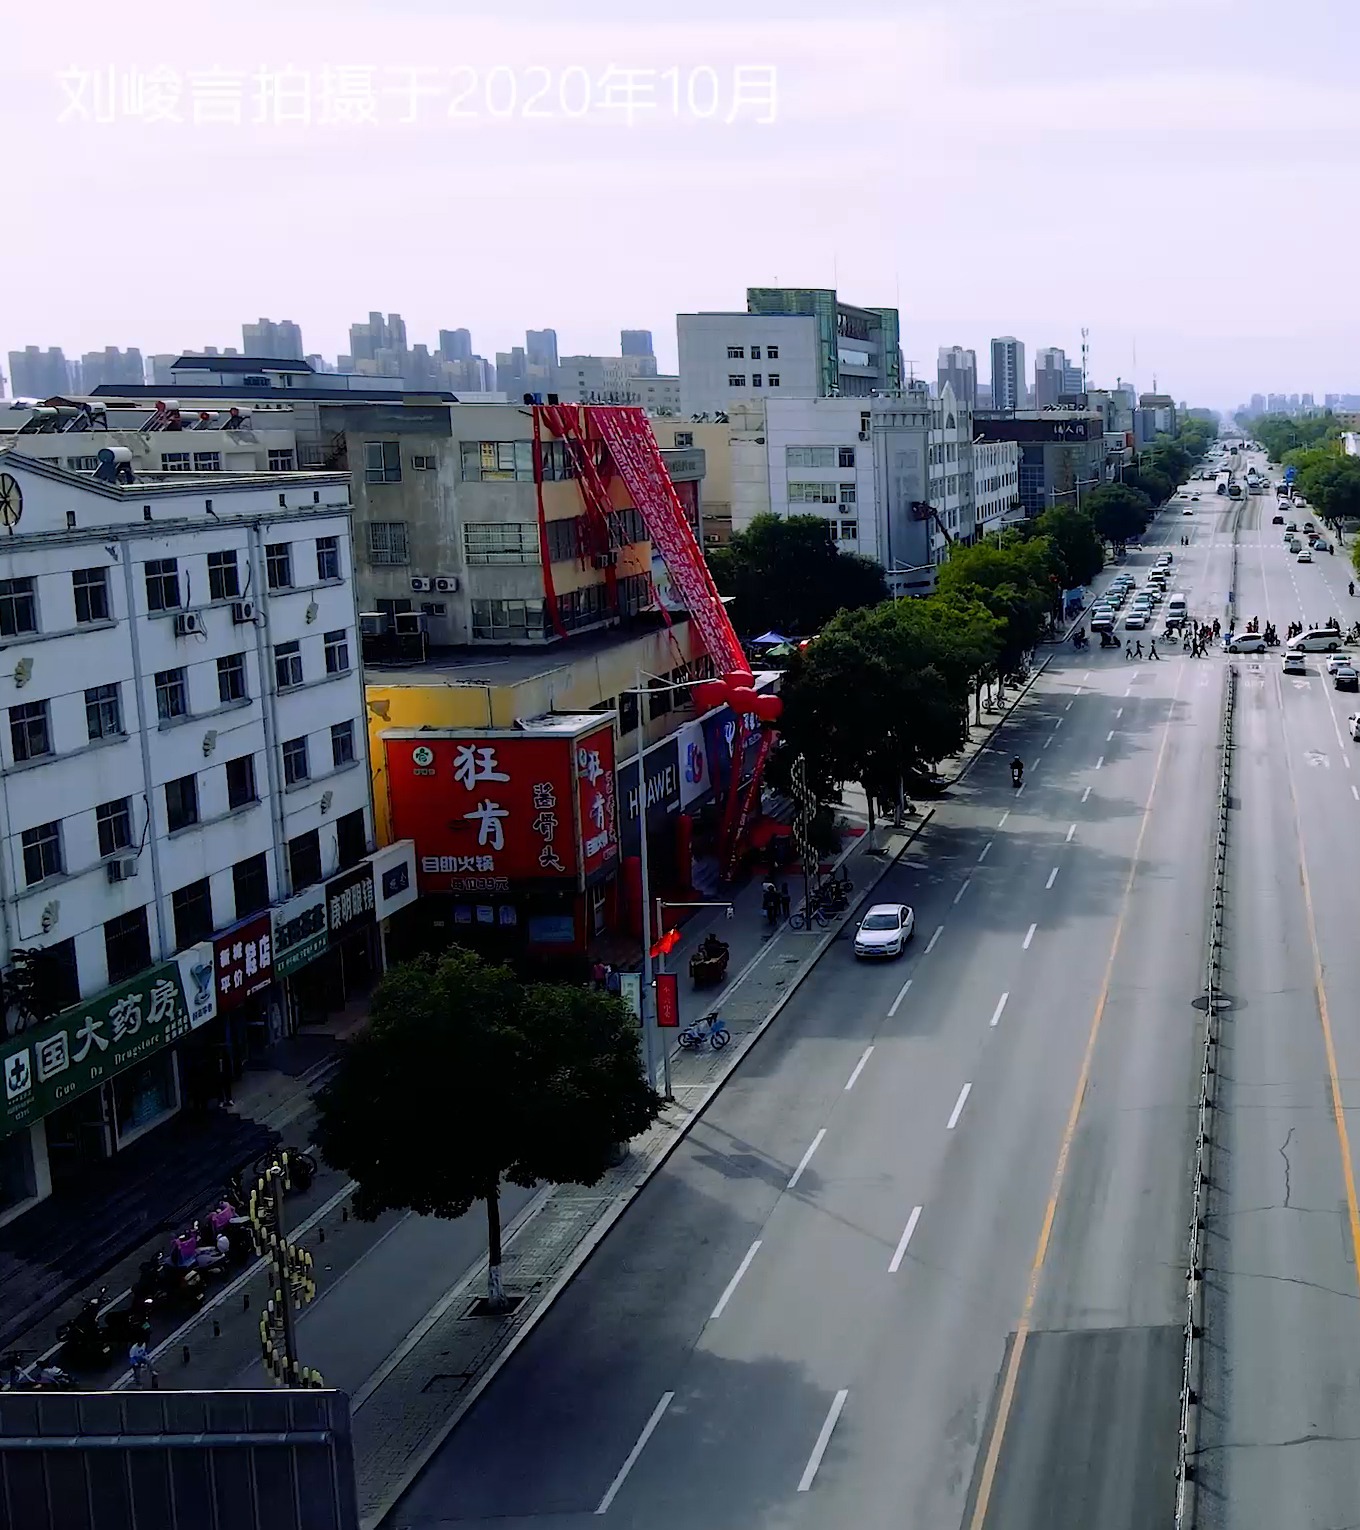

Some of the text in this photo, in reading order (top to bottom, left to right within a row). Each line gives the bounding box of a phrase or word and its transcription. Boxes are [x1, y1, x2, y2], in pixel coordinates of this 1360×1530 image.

[628, 763, 678, 820] HAWEI
[421, 855, 495, 873] 自助火锅
[35, 977, 180, 1084] 国大药房
